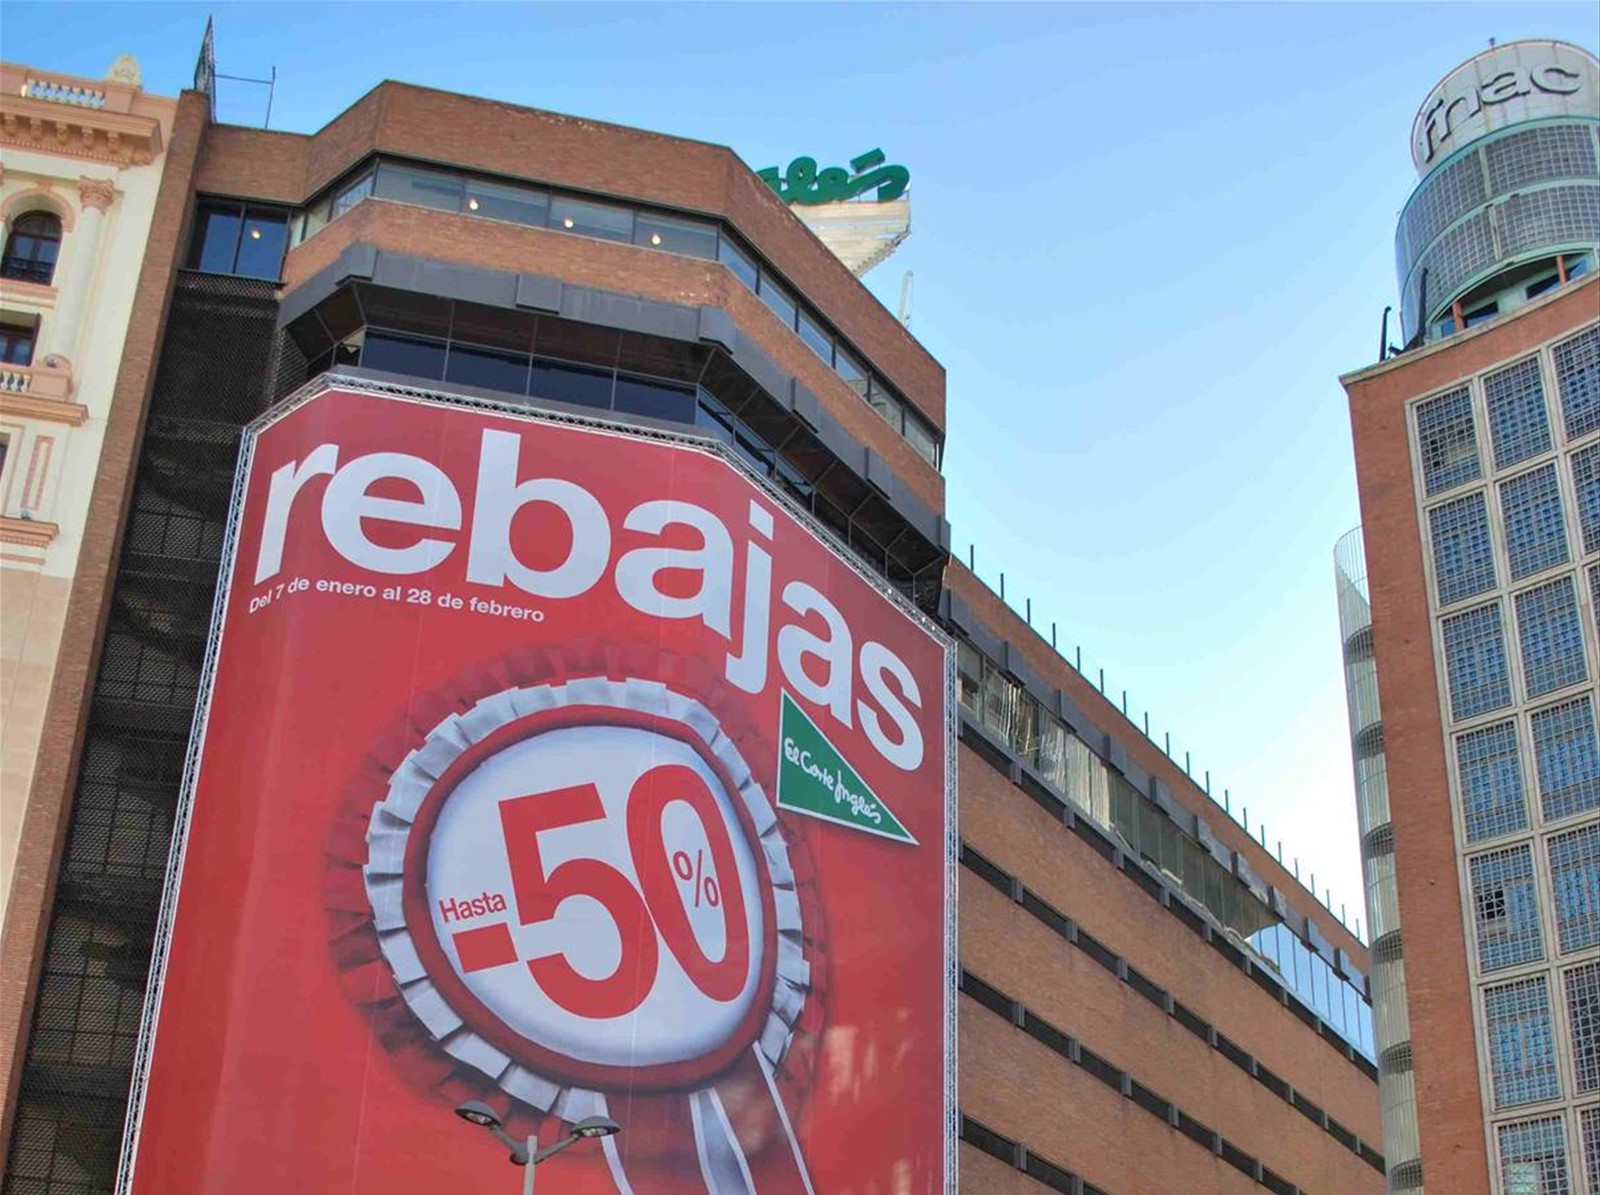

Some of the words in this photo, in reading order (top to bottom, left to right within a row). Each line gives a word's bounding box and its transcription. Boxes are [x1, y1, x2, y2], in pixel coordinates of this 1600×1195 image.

[1425, 62, 1582, 164] fnac
[249, 589, 272, 614] Del
[275, 583, 286, 602] 7
[287, 577, 310, 594] de
[316, 579, 377, 598] enero
[382, 585, 402, 602] al
[406, 587, 433, 605] 28
[437, 592, 464, 610] de
[469, 596, 545, 623] febrero
[255, 428, 925, 773] rebajas
[783, 737, 800, 766] El
[800, 750, 834, 791] Corte
[438, 892, 508, 924] Hasta
